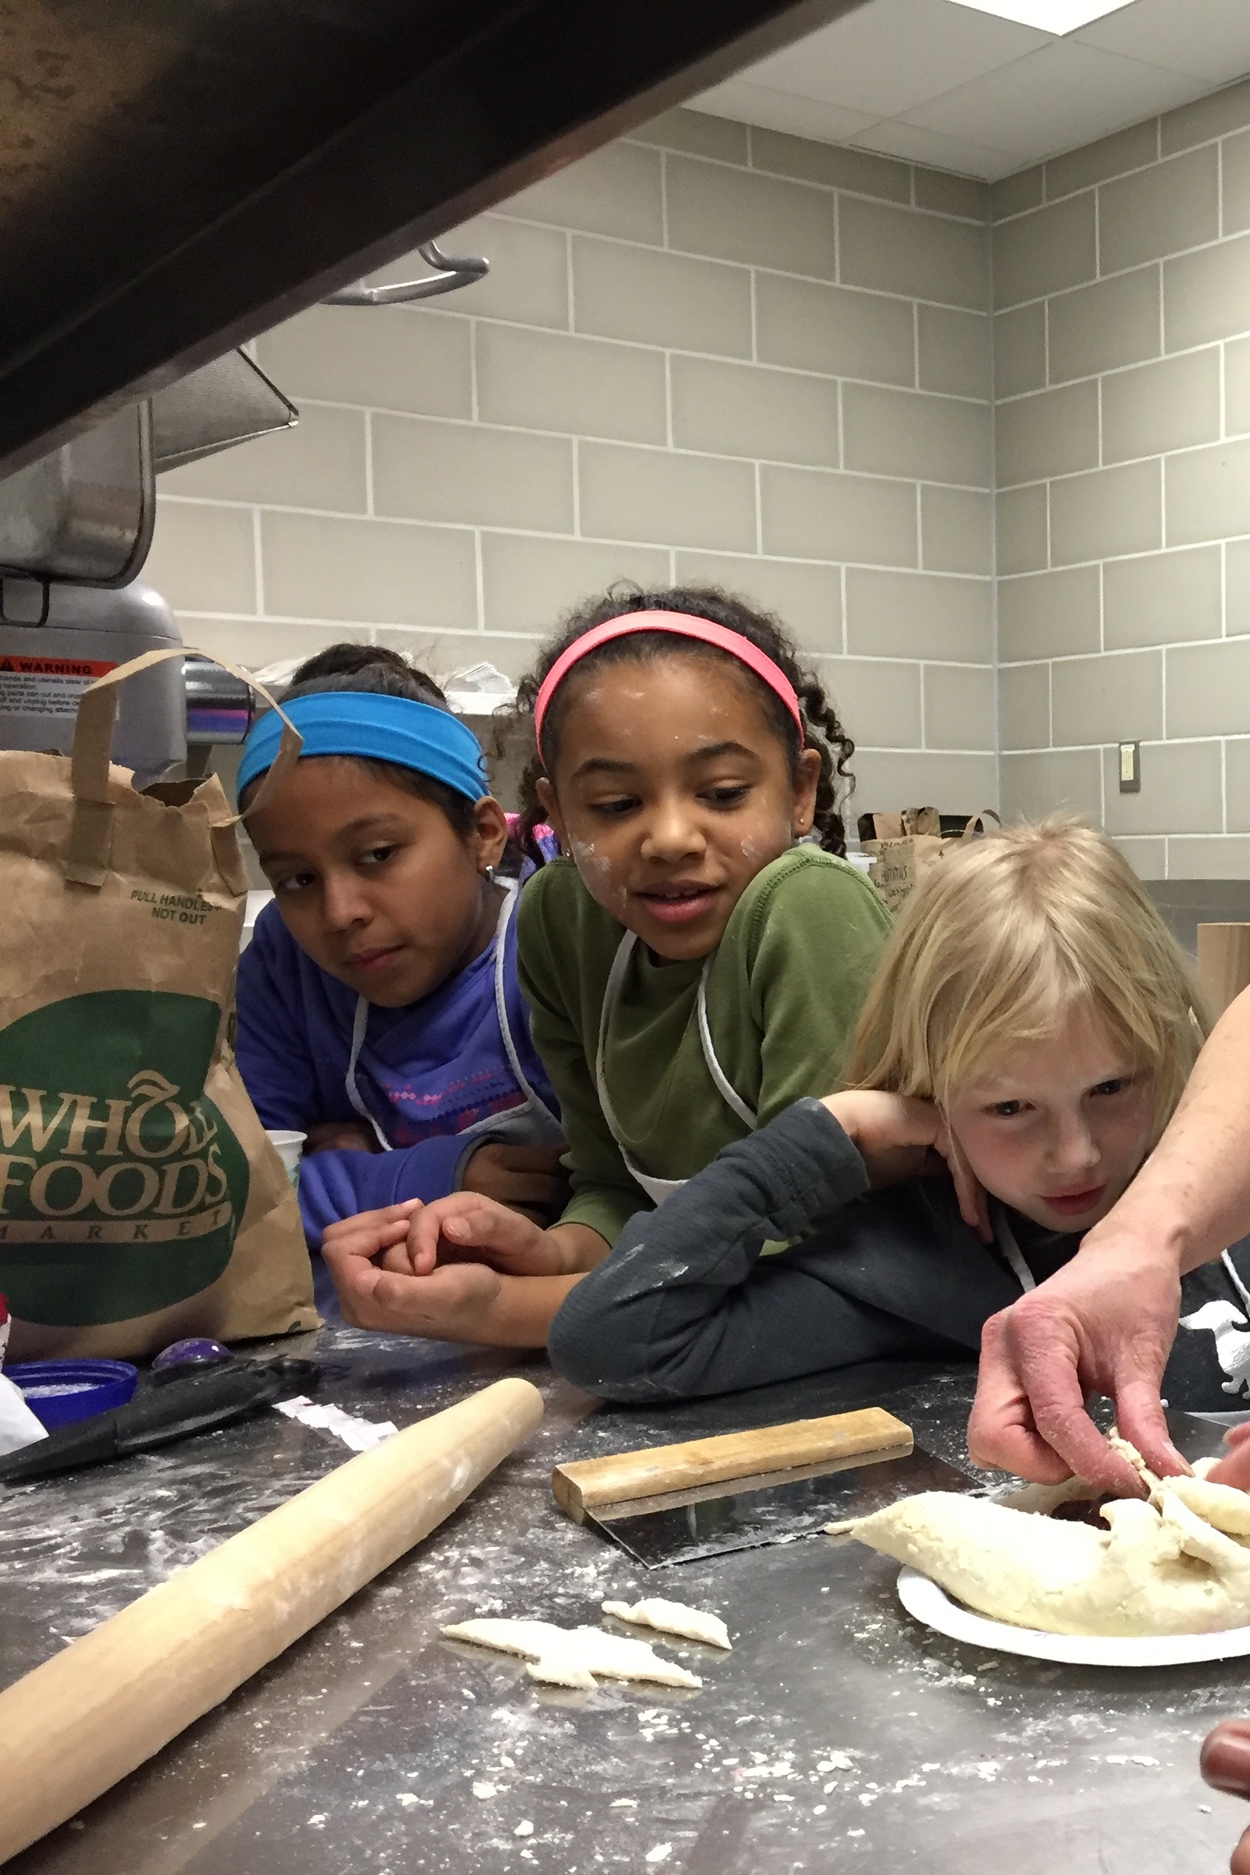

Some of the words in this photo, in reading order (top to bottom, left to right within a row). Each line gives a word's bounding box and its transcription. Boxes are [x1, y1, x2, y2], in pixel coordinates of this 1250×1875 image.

[20, 662, 92, 675] WARNING
[130, 889, 156, 904] PULL
[151, 907, 177, 920] NOT
[179, 912, 206, 925] OUT
[0, 1143, 227, 1217] FOODS
